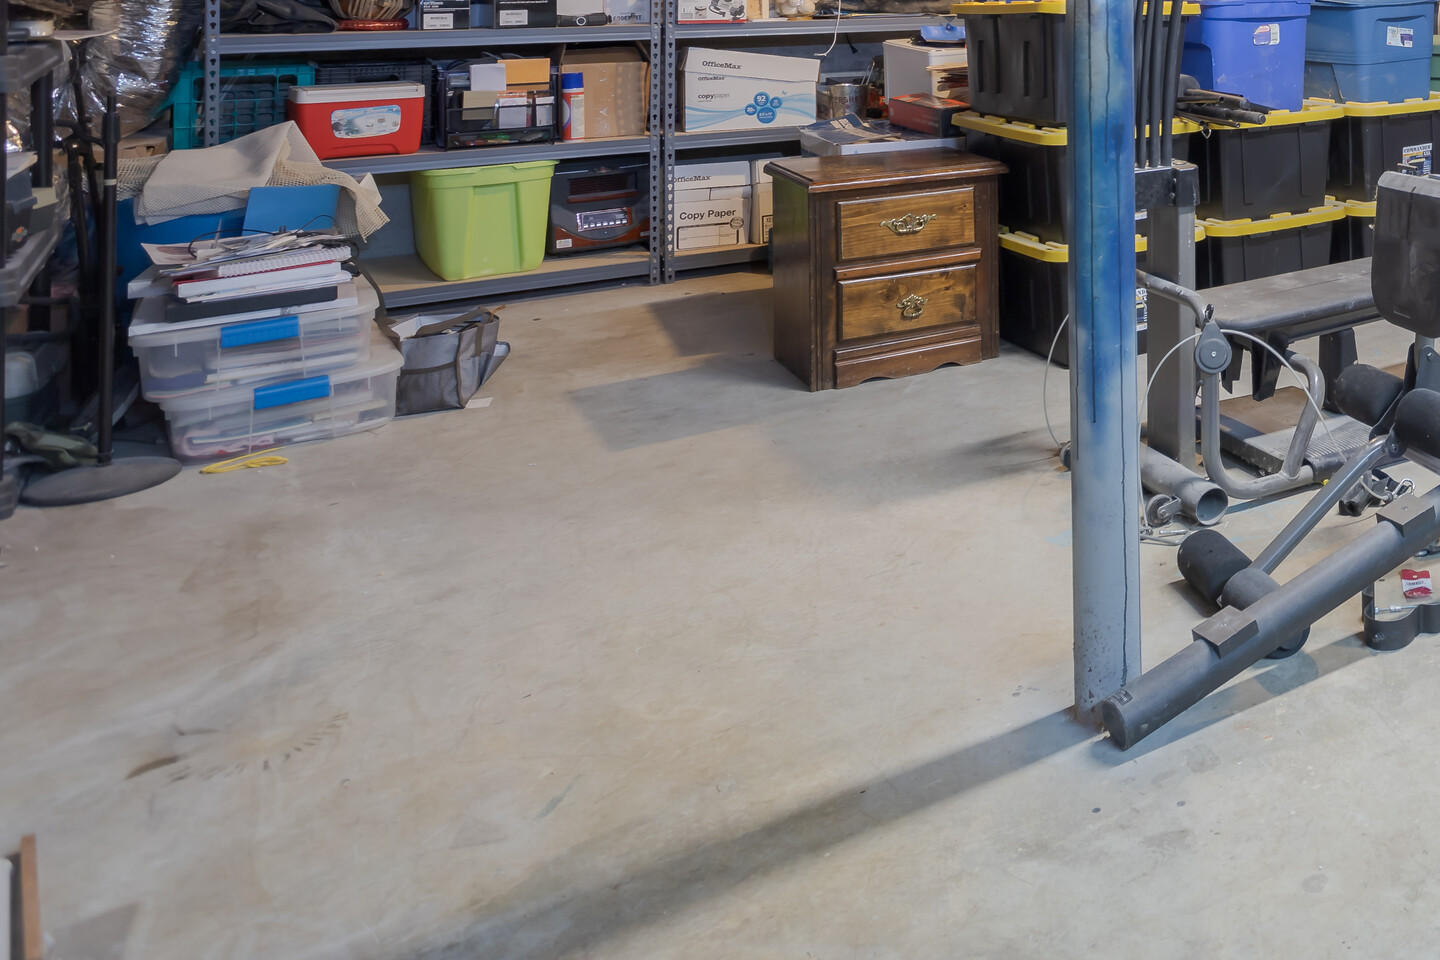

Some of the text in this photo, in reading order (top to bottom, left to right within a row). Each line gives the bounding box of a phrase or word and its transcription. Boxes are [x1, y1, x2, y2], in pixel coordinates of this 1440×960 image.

[702, 60, 741, 70] OfficeMax
[680, 208, 737, 221] Copy Paper
